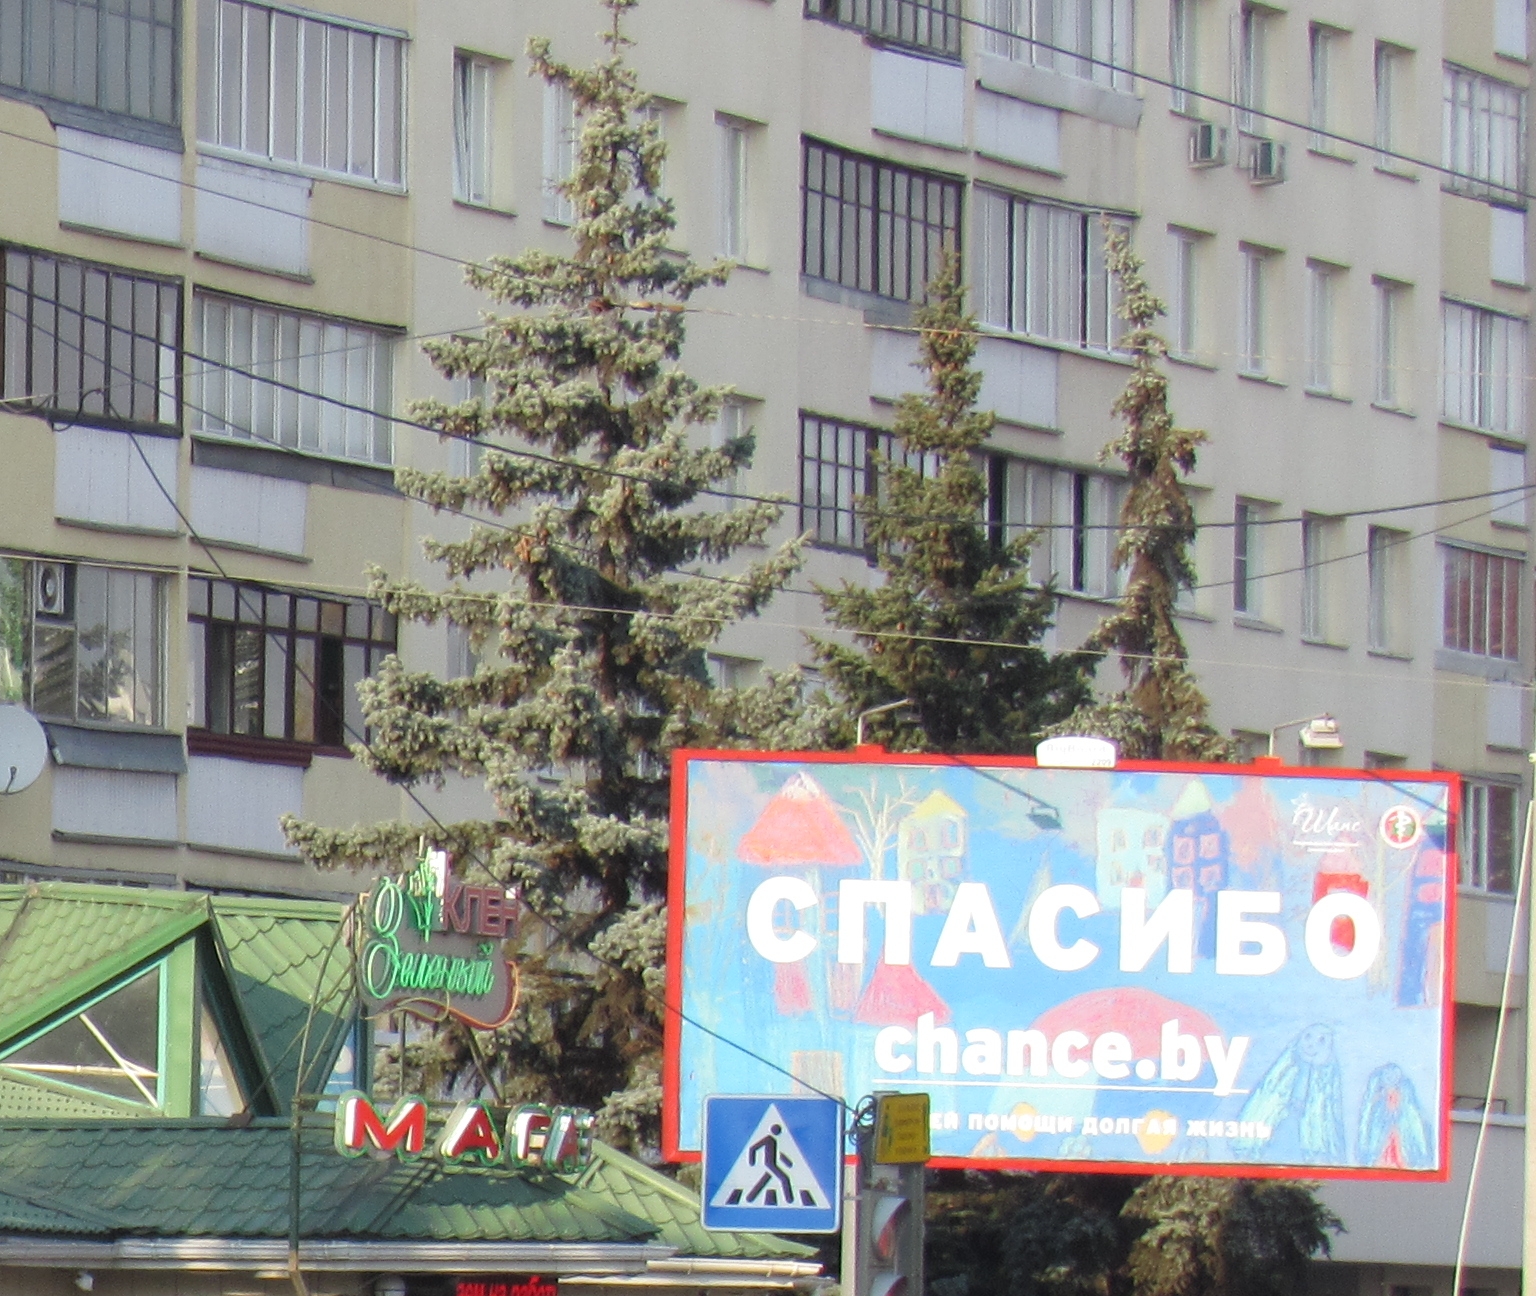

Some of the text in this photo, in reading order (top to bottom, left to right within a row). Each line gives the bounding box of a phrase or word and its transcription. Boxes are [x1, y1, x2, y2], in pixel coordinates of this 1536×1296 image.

[746, 874, 1387, 980] СПАСИБО
[874, 1012, 1250, 1096] chance.by
[929, 1111, 1273, 1140] ЕЙ ПОМОЩИ ДОЛГАЯ ЖИЗНЬ
